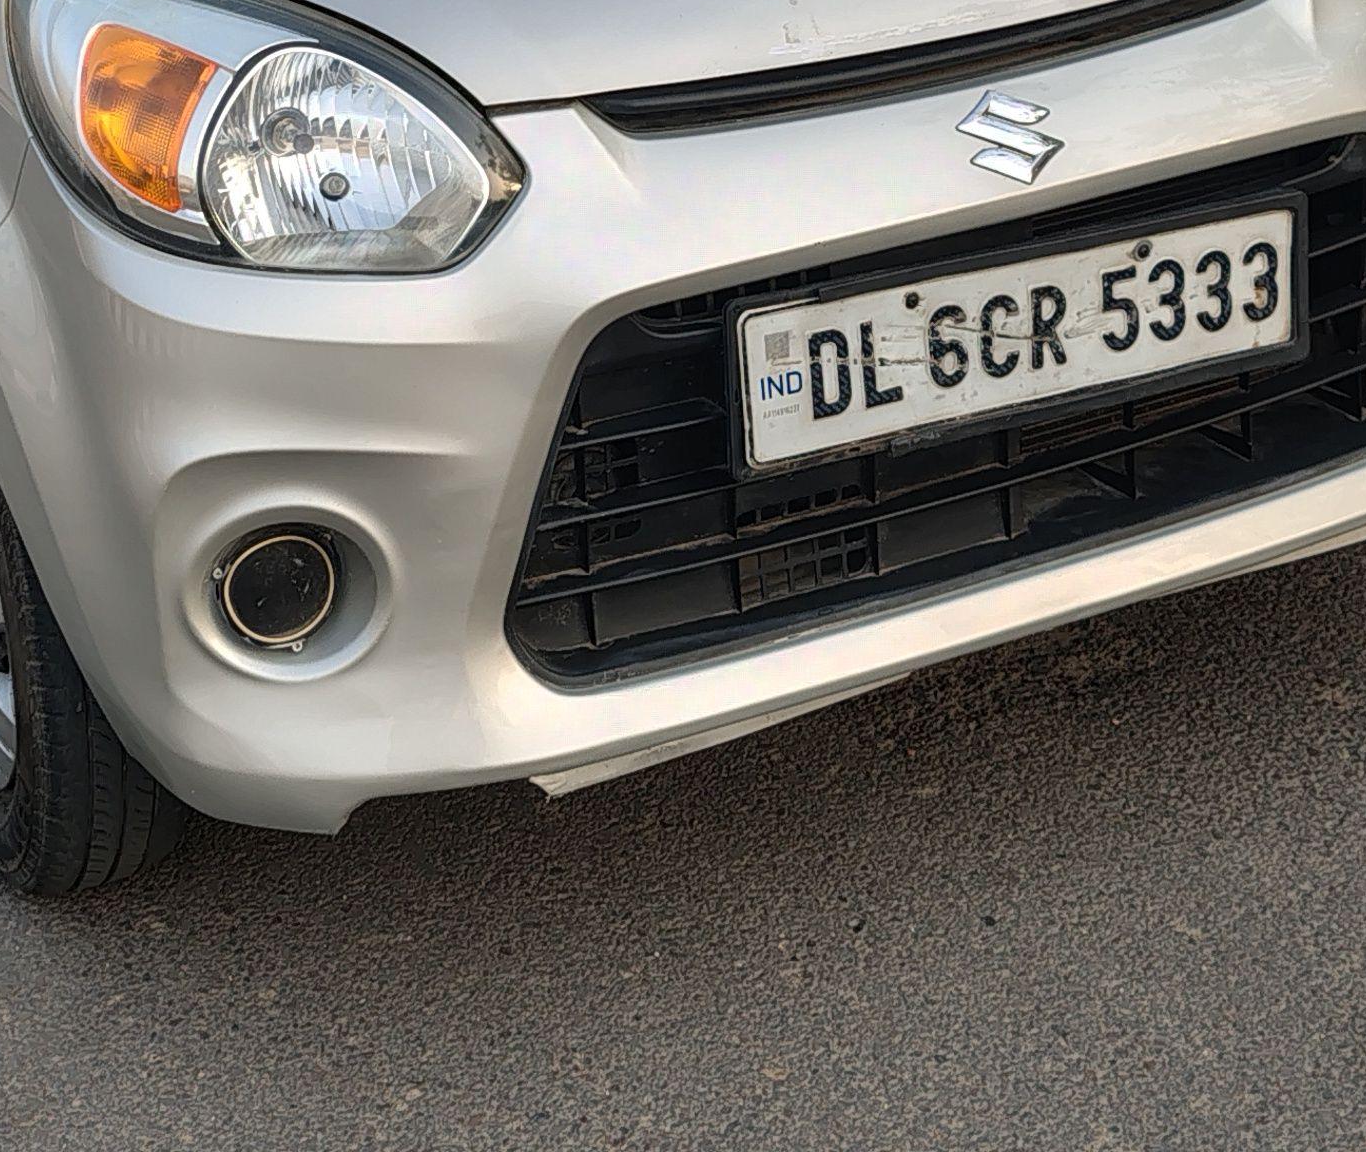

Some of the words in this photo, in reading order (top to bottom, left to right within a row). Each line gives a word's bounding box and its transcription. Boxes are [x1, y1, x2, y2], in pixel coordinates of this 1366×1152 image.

[808, 320, 904, 421] DL
[927, 285, 1067, 389] 6CR
[1101, 242, 1279, 352] 5333
[760, 370, 803, 401] IND
